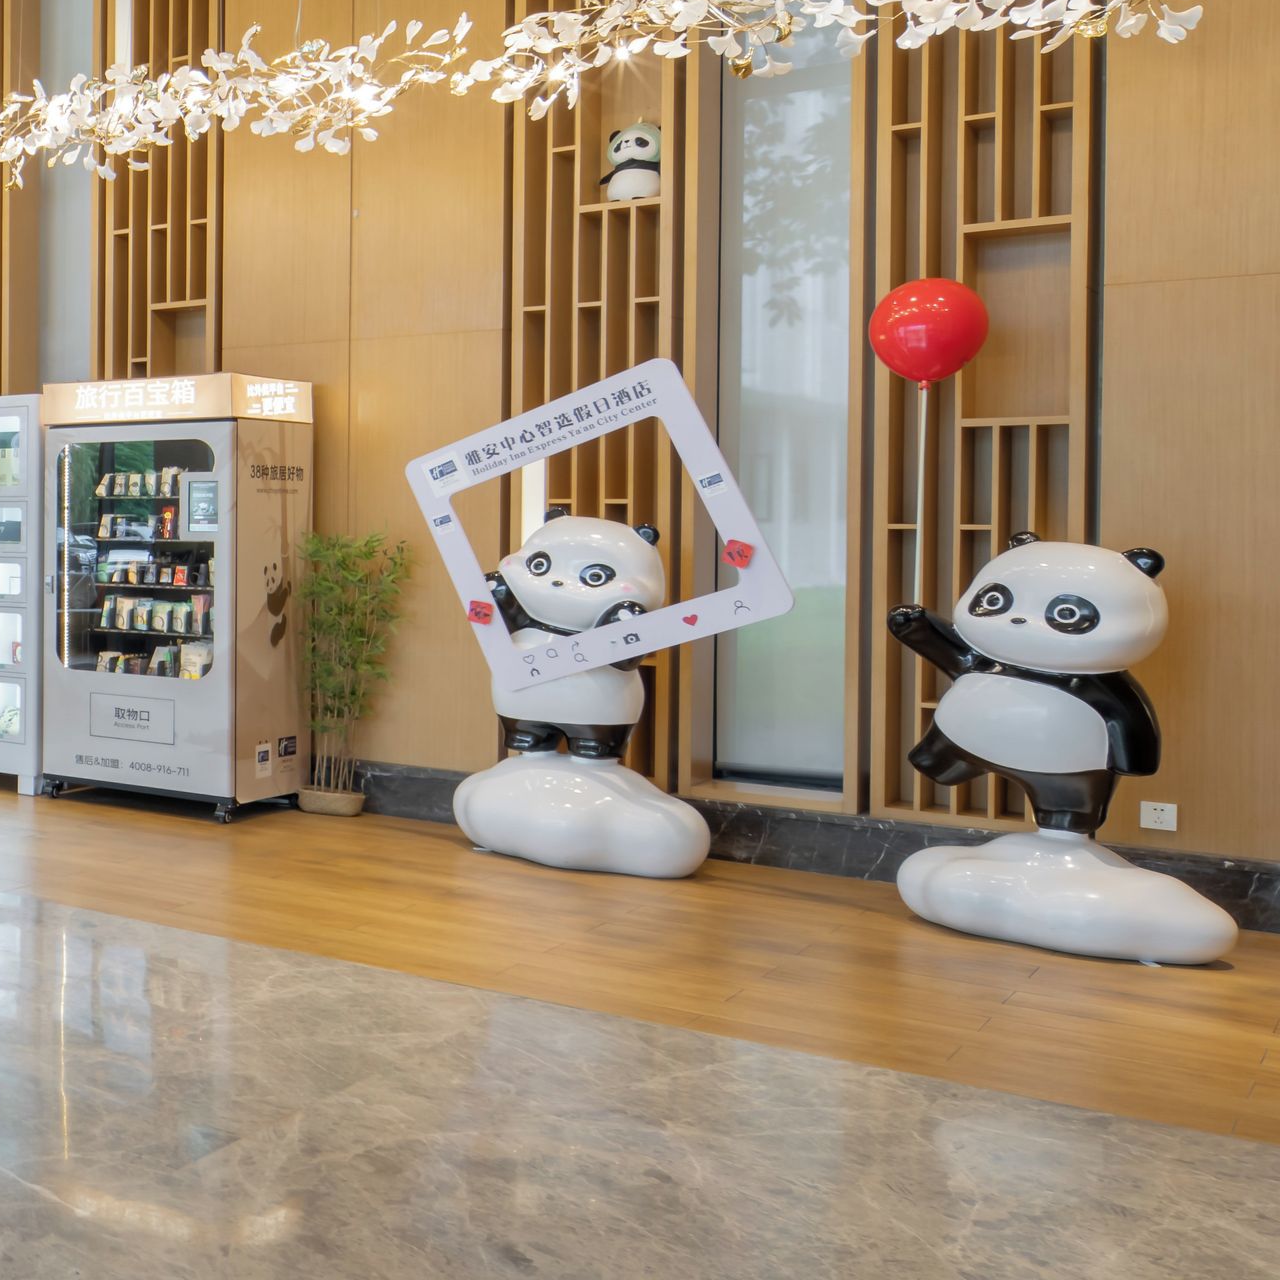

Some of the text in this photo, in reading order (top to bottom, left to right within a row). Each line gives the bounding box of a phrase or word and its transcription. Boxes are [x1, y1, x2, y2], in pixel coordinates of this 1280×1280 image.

[74, 379, 196, 410] 旅行百宝箱
[464, 379, 653, 467] 雅安中心智选假日酒店
[471, 458, 509, 477] Holiday
[510, 449, 527, 461] Inn
[527, 435, 568, 455] Express
[596, 412, 620, 427] City
[620, 397, 658, 417] Center
[250, 464, 304, 482] 38种旅居好物
[113, 707, 150, 722] 取物口
[113, 720, 150, 731] Access Port
